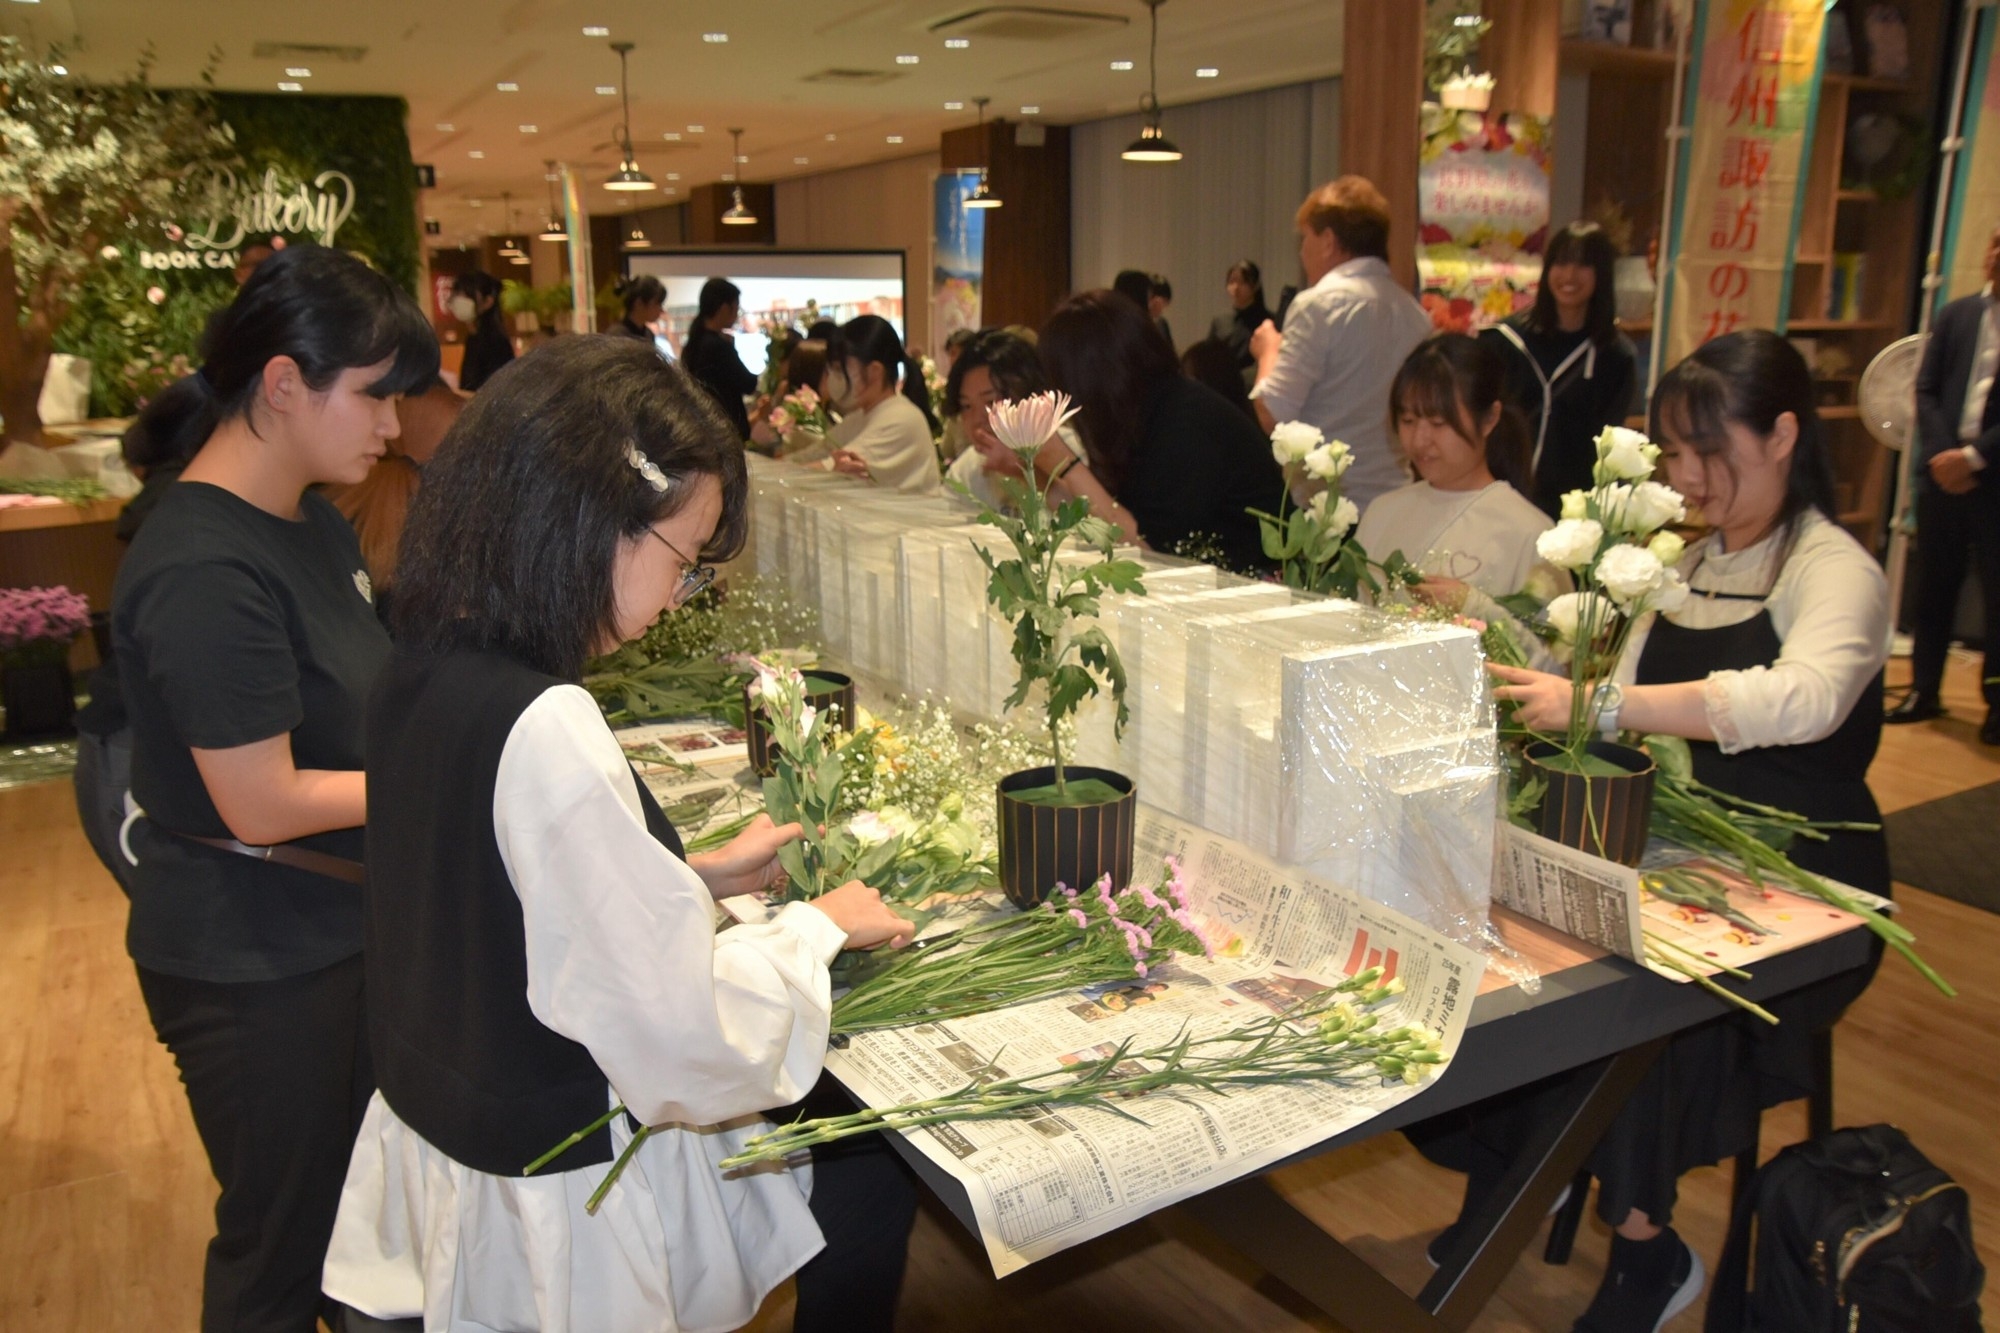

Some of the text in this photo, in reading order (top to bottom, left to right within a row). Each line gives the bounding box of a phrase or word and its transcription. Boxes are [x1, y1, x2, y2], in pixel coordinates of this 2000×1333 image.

[184, 162, 355, 248] Bakery
[140, 250, 240, 270] BOOK CA
